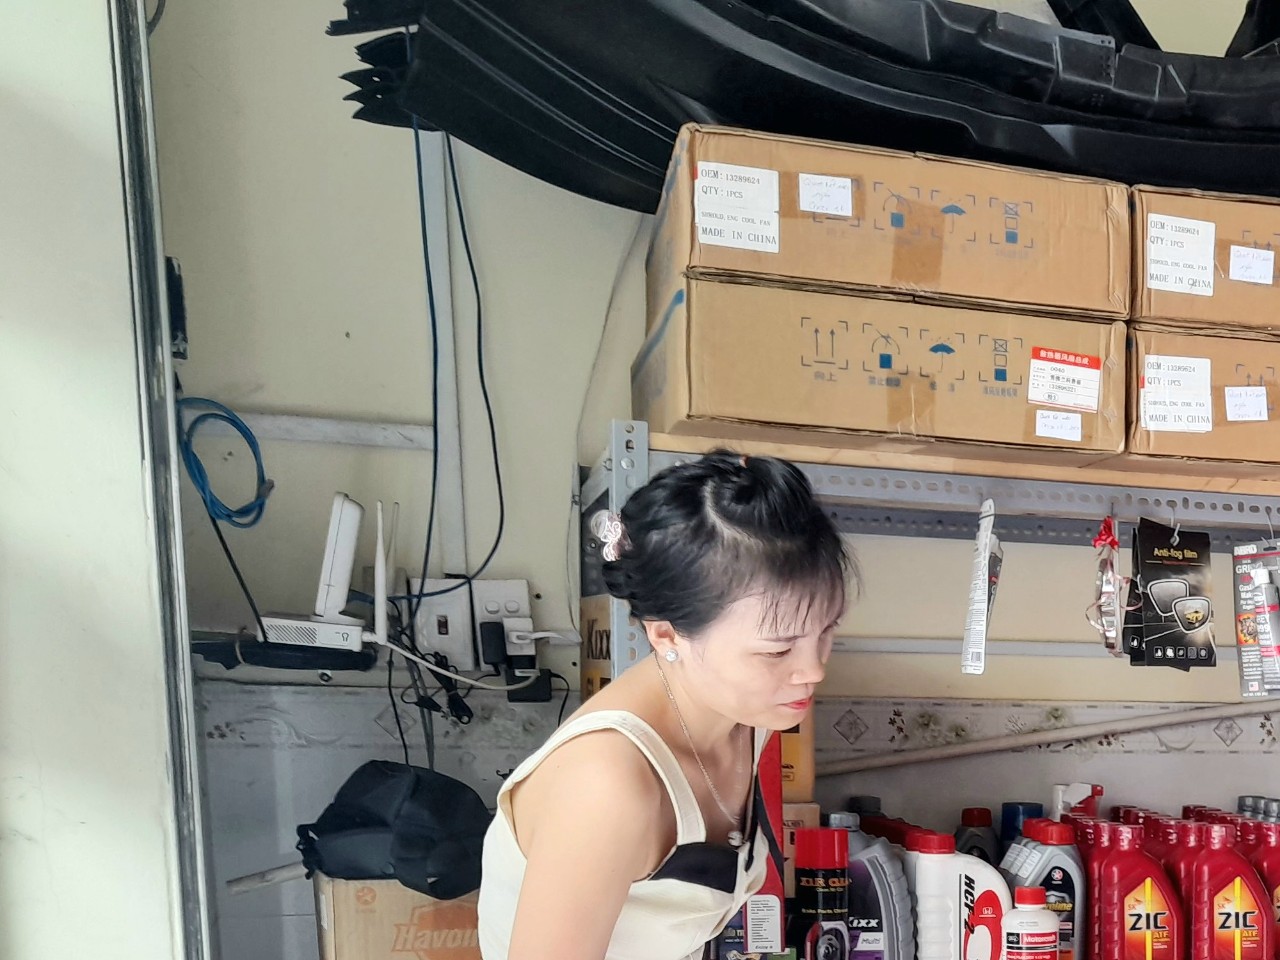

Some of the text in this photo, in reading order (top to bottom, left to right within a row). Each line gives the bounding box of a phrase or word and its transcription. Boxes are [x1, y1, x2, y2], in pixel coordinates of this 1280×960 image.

[701, 227, 777, 245] MADE IN CHINA
[1149, 273, 1212, 289] MADE IN CHINA
[1149, 414, 1211, 424] MADE IN CHINA
[1153, 547, 1183, 560] Anti-fog
[1233, 544, 1257, 556] ABRO
[964, 874, 975, 934] HCF-2
[1128, 911, 1169, 931] ZIC
[1217, 910, 1259, 930] ZIC
[1153, 931, 1169, 939] ATF
